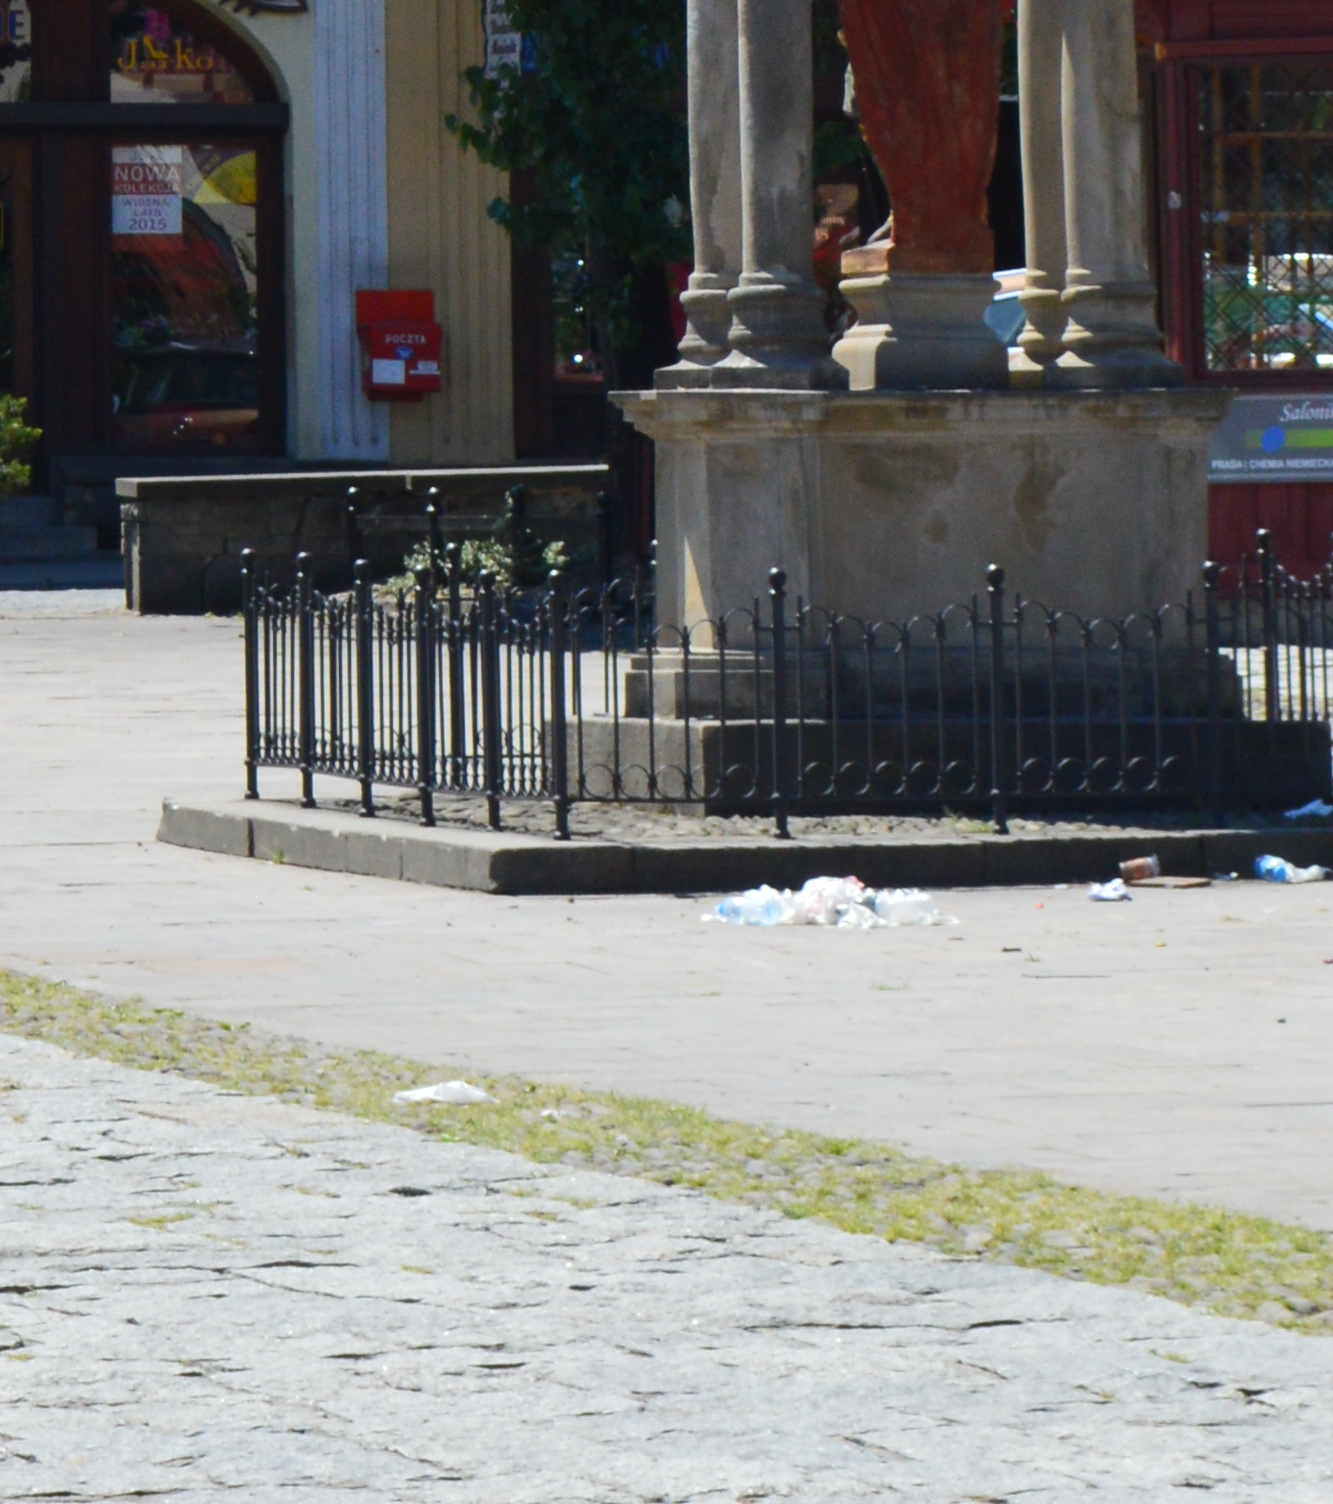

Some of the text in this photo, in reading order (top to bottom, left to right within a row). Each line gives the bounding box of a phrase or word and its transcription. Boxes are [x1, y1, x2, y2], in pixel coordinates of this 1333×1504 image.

[115, 166, 180, 181] NOWA
[129, 219, 167, 231] 2015
[385, 334, 426, 344] POCZTA
[1280, 401, 1333, 422] Saloni
